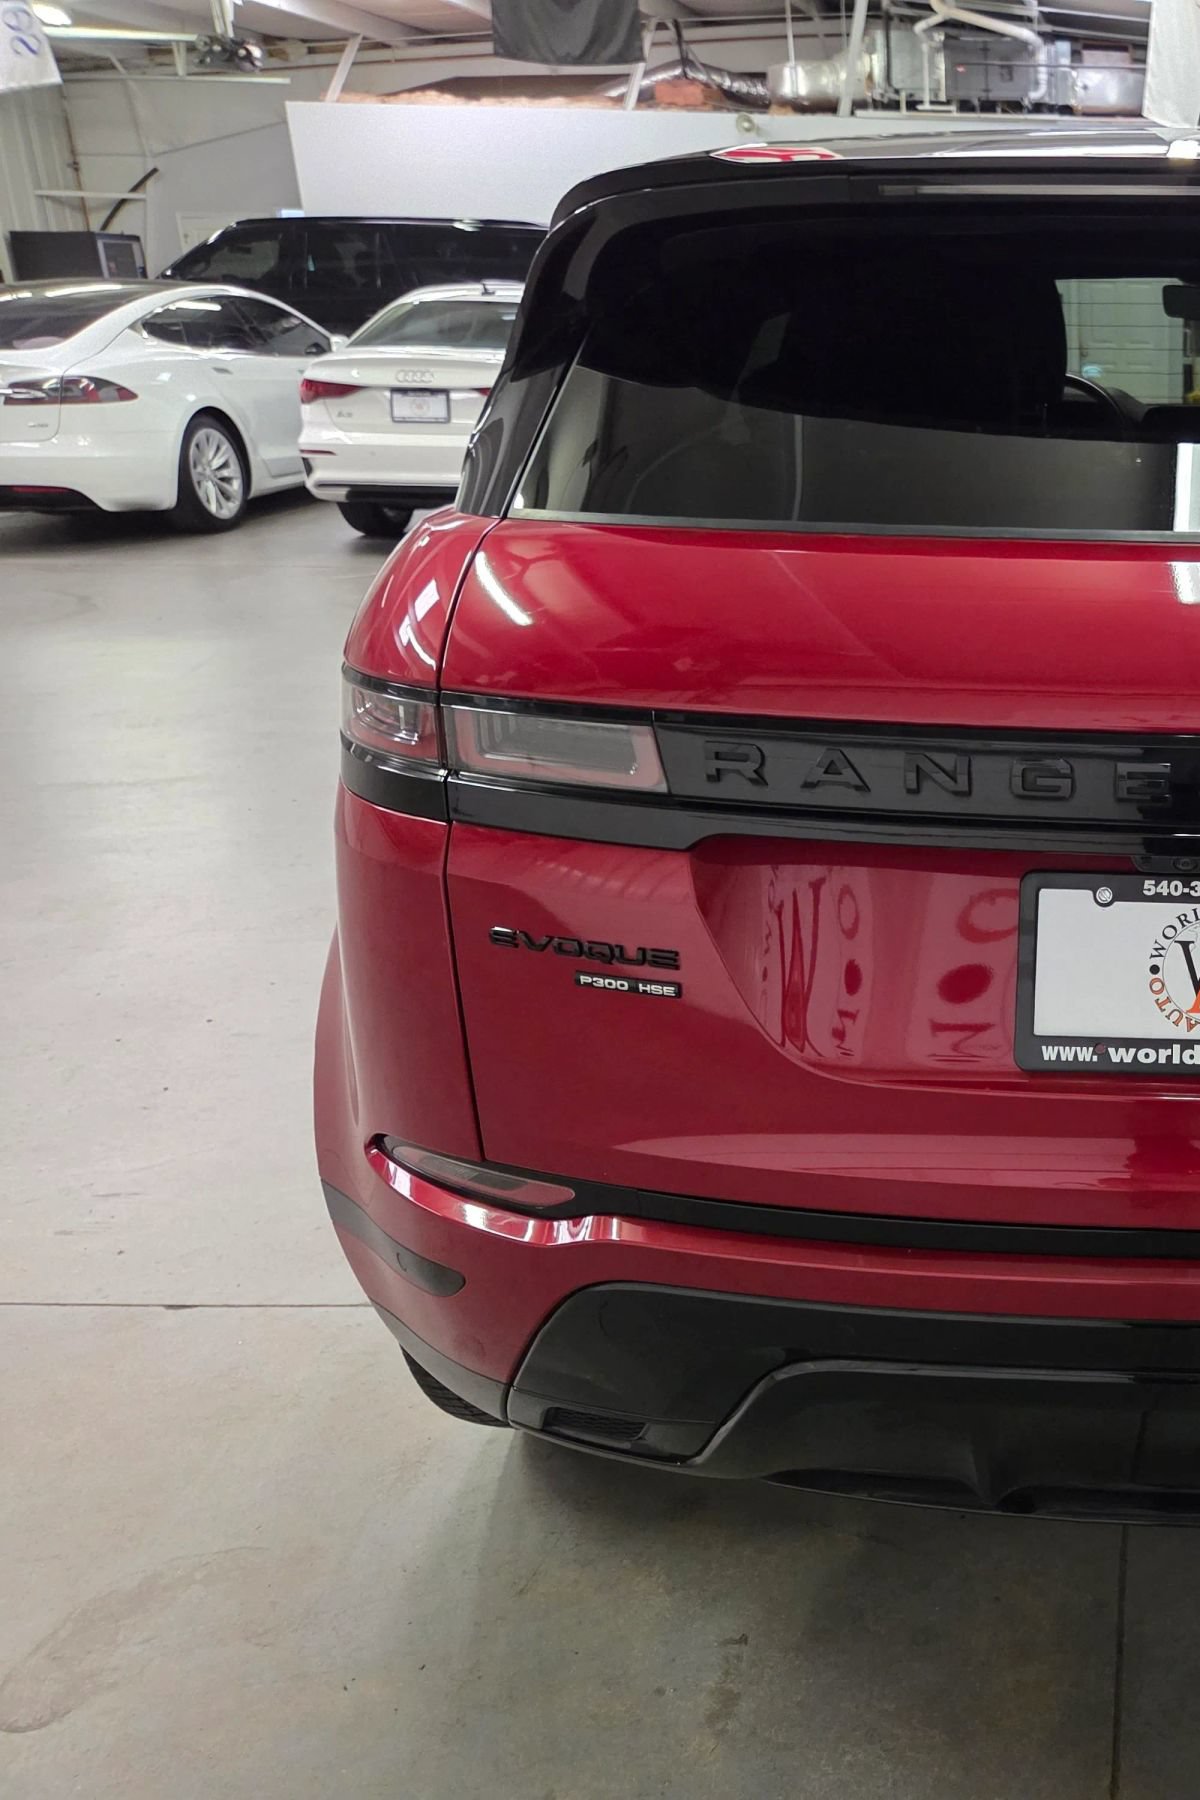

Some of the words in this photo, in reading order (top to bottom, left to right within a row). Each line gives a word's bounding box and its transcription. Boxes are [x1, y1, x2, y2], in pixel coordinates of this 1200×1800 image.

[704, 740, 1171, 801] RANGE
[489, 926, 680, 970] EVOQUE
[579, 975, 629, 991] P300
[638, 983, 676, 997] HSE
[1149, 977, 1200, 1032] AUTO
